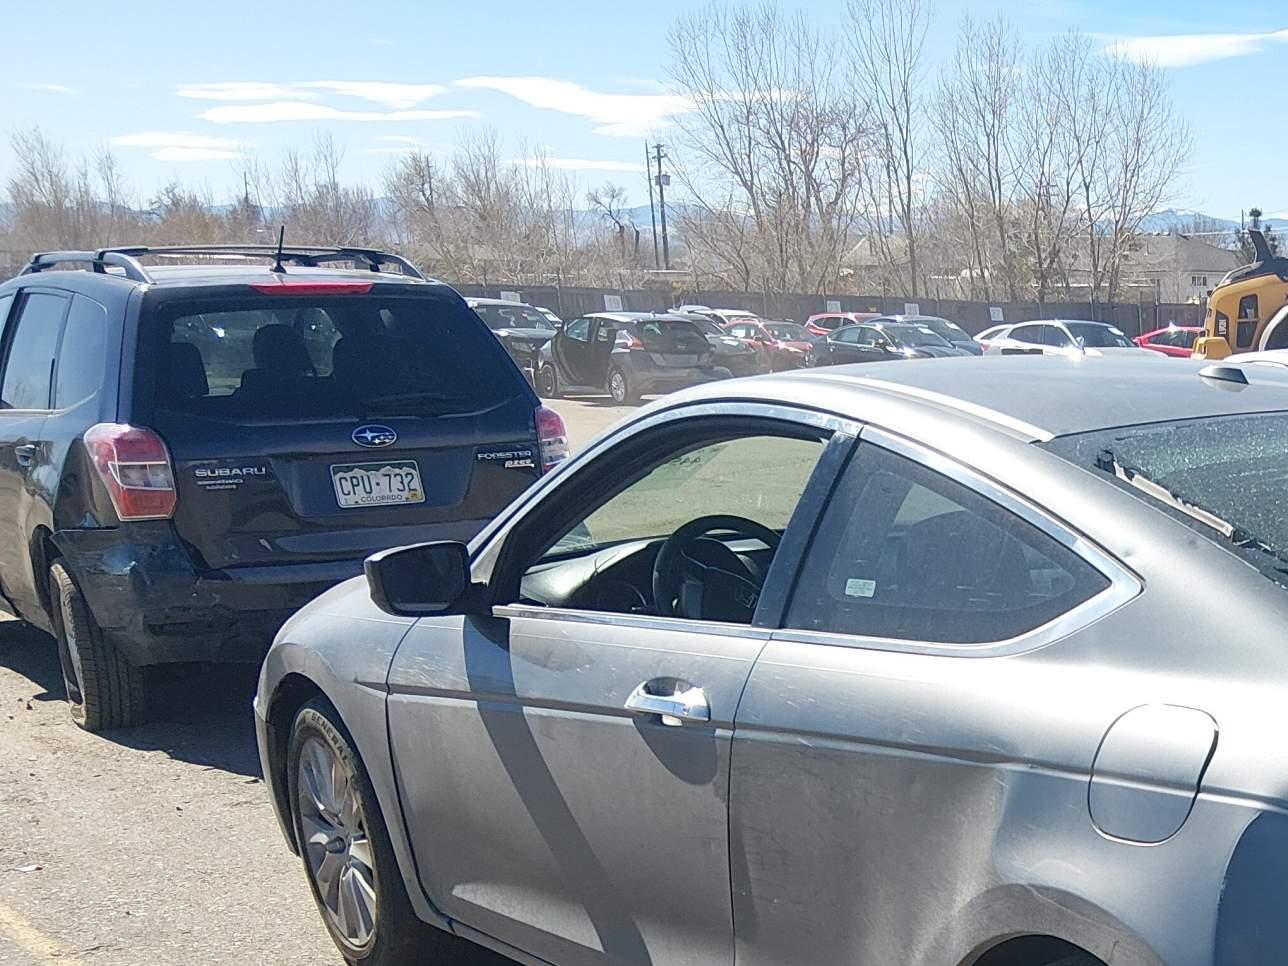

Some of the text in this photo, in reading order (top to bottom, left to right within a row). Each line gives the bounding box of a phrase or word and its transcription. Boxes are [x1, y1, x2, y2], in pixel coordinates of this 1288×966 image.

[477, 451, 532, 460] FORESTER
[195, 466, 266, 477] SUBARU
[361, 494, 403, 503] COLORADO
